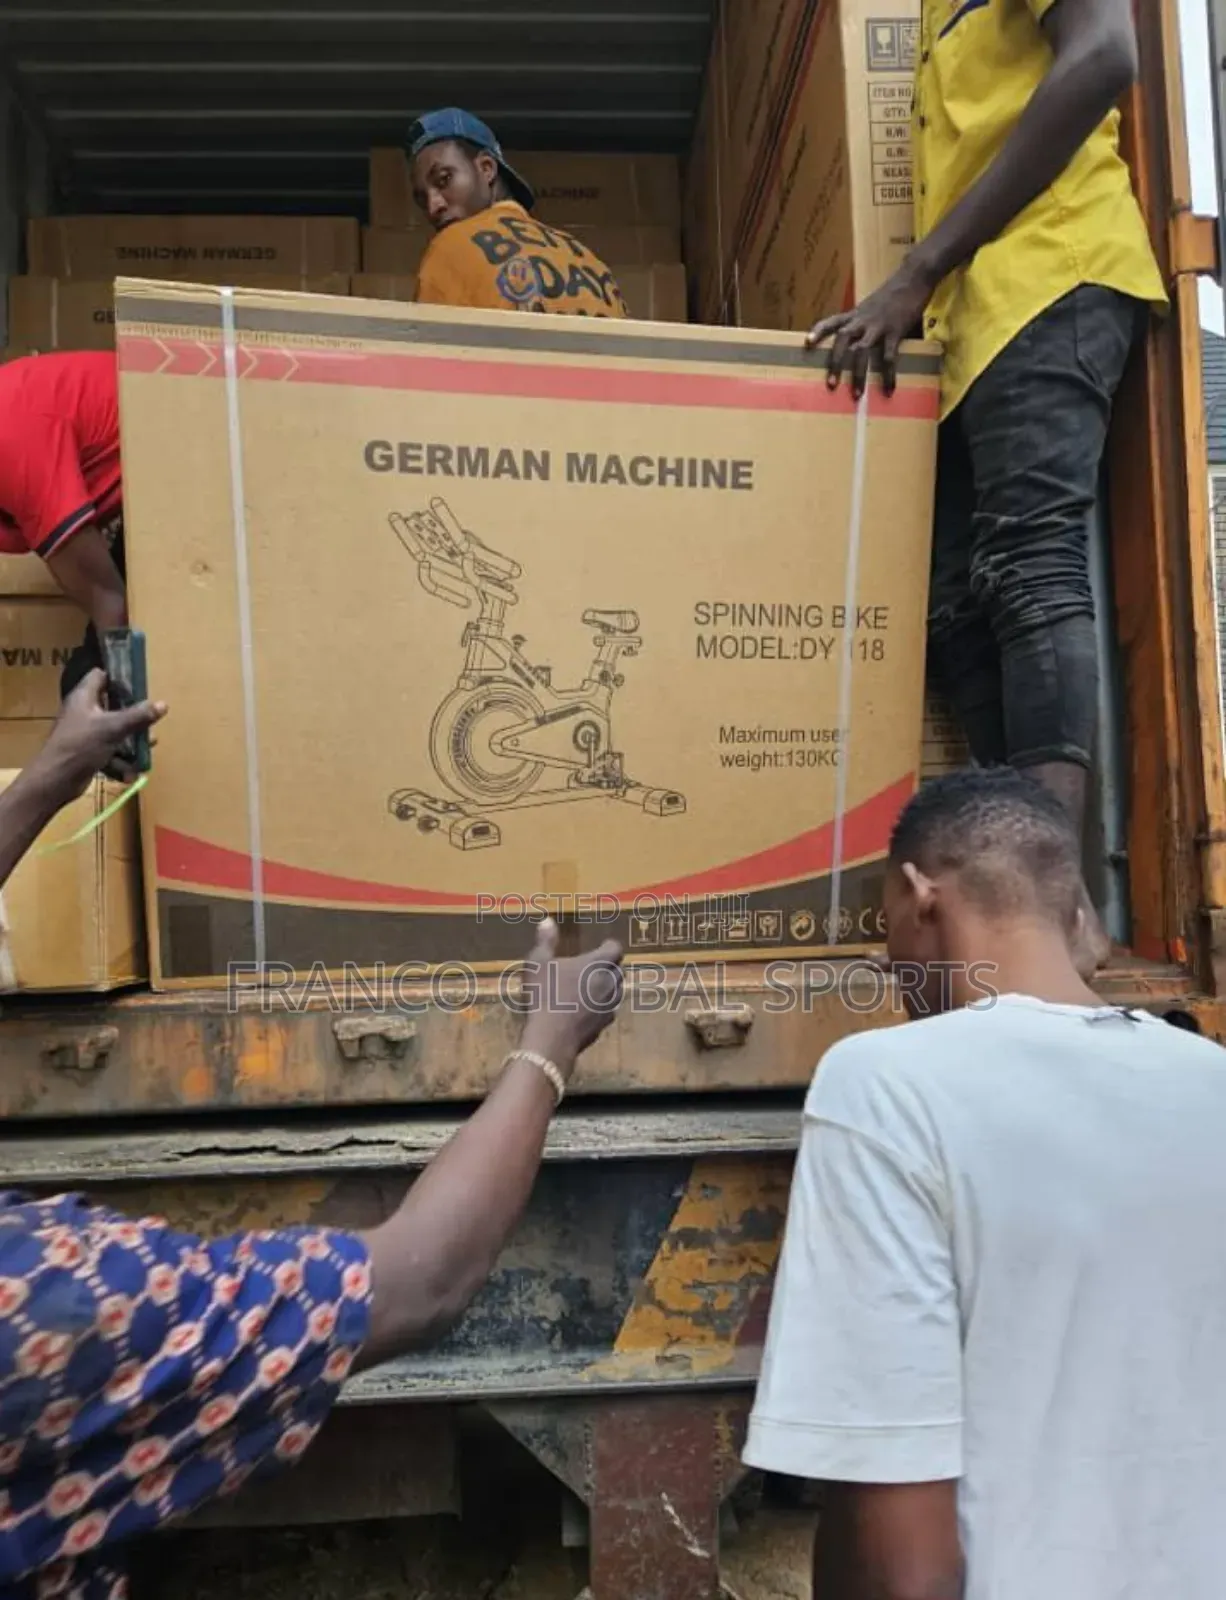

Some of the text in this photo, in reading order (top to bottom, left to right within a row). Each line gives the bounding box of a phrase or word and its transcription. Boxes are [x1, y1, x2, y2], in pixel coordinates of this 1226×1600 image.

[115, 246, 278, 261] GERMAN MACHINE
[363, 439, 755, 491] GERMAN MACHINE
[693, 601, 890, 631] SPINNING BKE
[718, 725, 806, 744] Maximum
